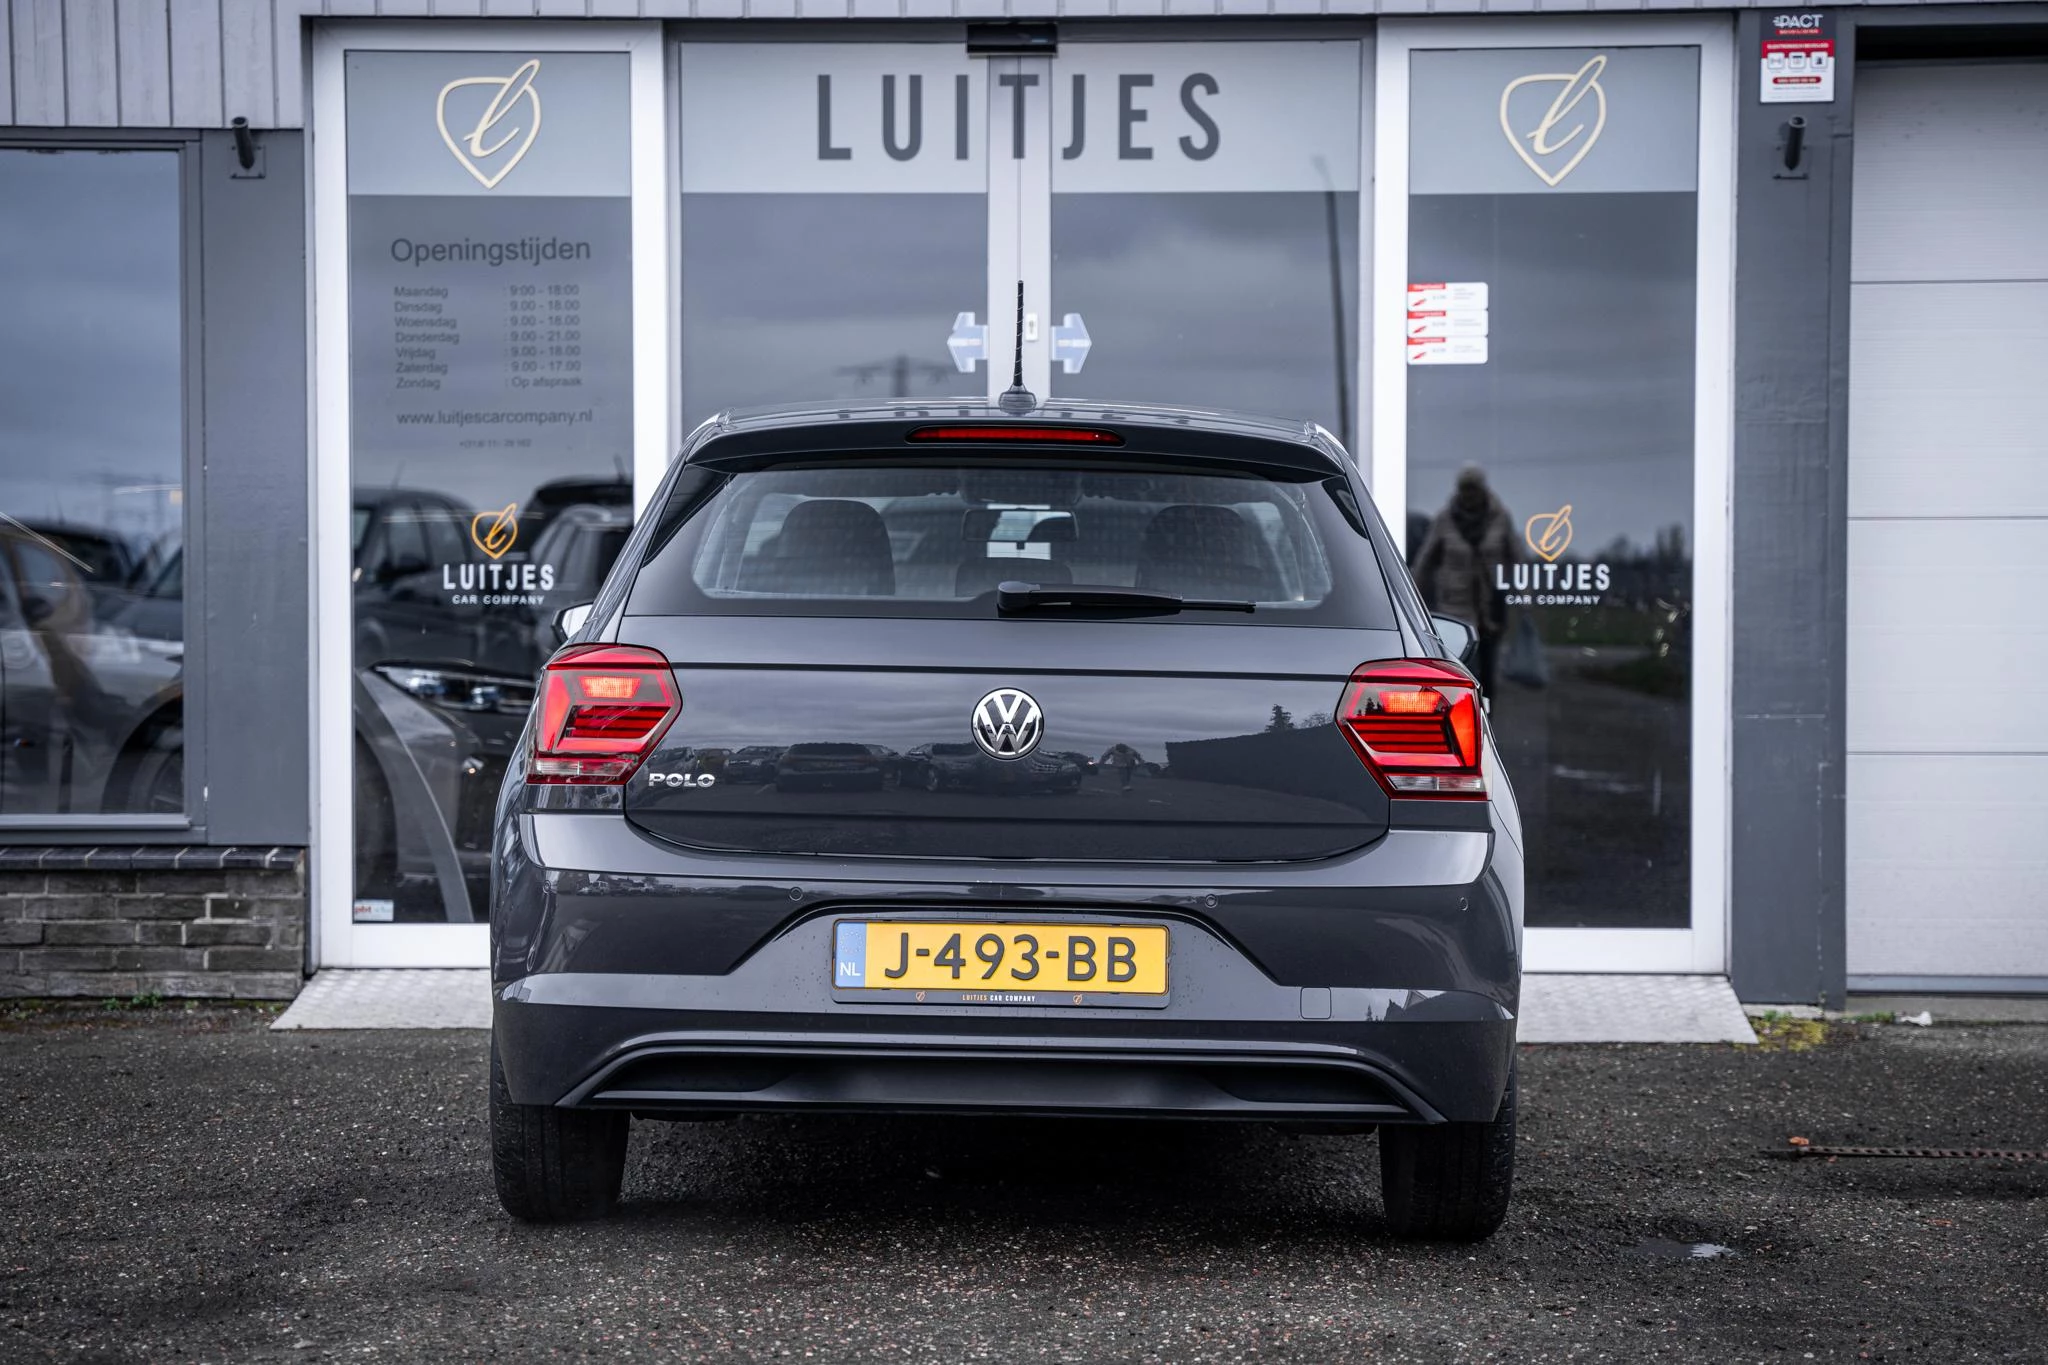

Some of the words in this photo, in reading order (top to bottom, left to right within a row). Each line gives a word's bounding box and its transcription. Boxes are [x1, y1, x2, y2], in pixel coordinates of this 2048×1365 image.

[817, 73, 1220, 161] LUITJES
[391, 237, 591, 267] Openingstijden
[394, 286, 449, 299] Maandag
[394, 301, 443, 314] Dinsdag
[394, 317, 457, 329] Woensdag
[395, 332, 460, 345] Donderdag
[396, 347, 436, 360] Vrijdag
[396, 362, 448, 375] Zaterdag
[396, 377, 441, 390] Zondag
[511, 376, 530, 388] Op
[532, 375, 582, 388] afspraak
[396, 409, 593, 427] www.luitjescarcompany.nl
[443, 563, 554, 591] LUITJES
[1496, 563, 1610, 591] LUITJES
[452, 594, 478, 605] CAR
[483, 594, 545, 605] COMPANY
[1505, 594, 1532, 605] CAR
[1536, 594, 1601, 605] COMPANY
[648, 773, 715, 787] POLO
[884, 932, 1137, 982] J-493-BB
[839, 961, 861, 977] NL
